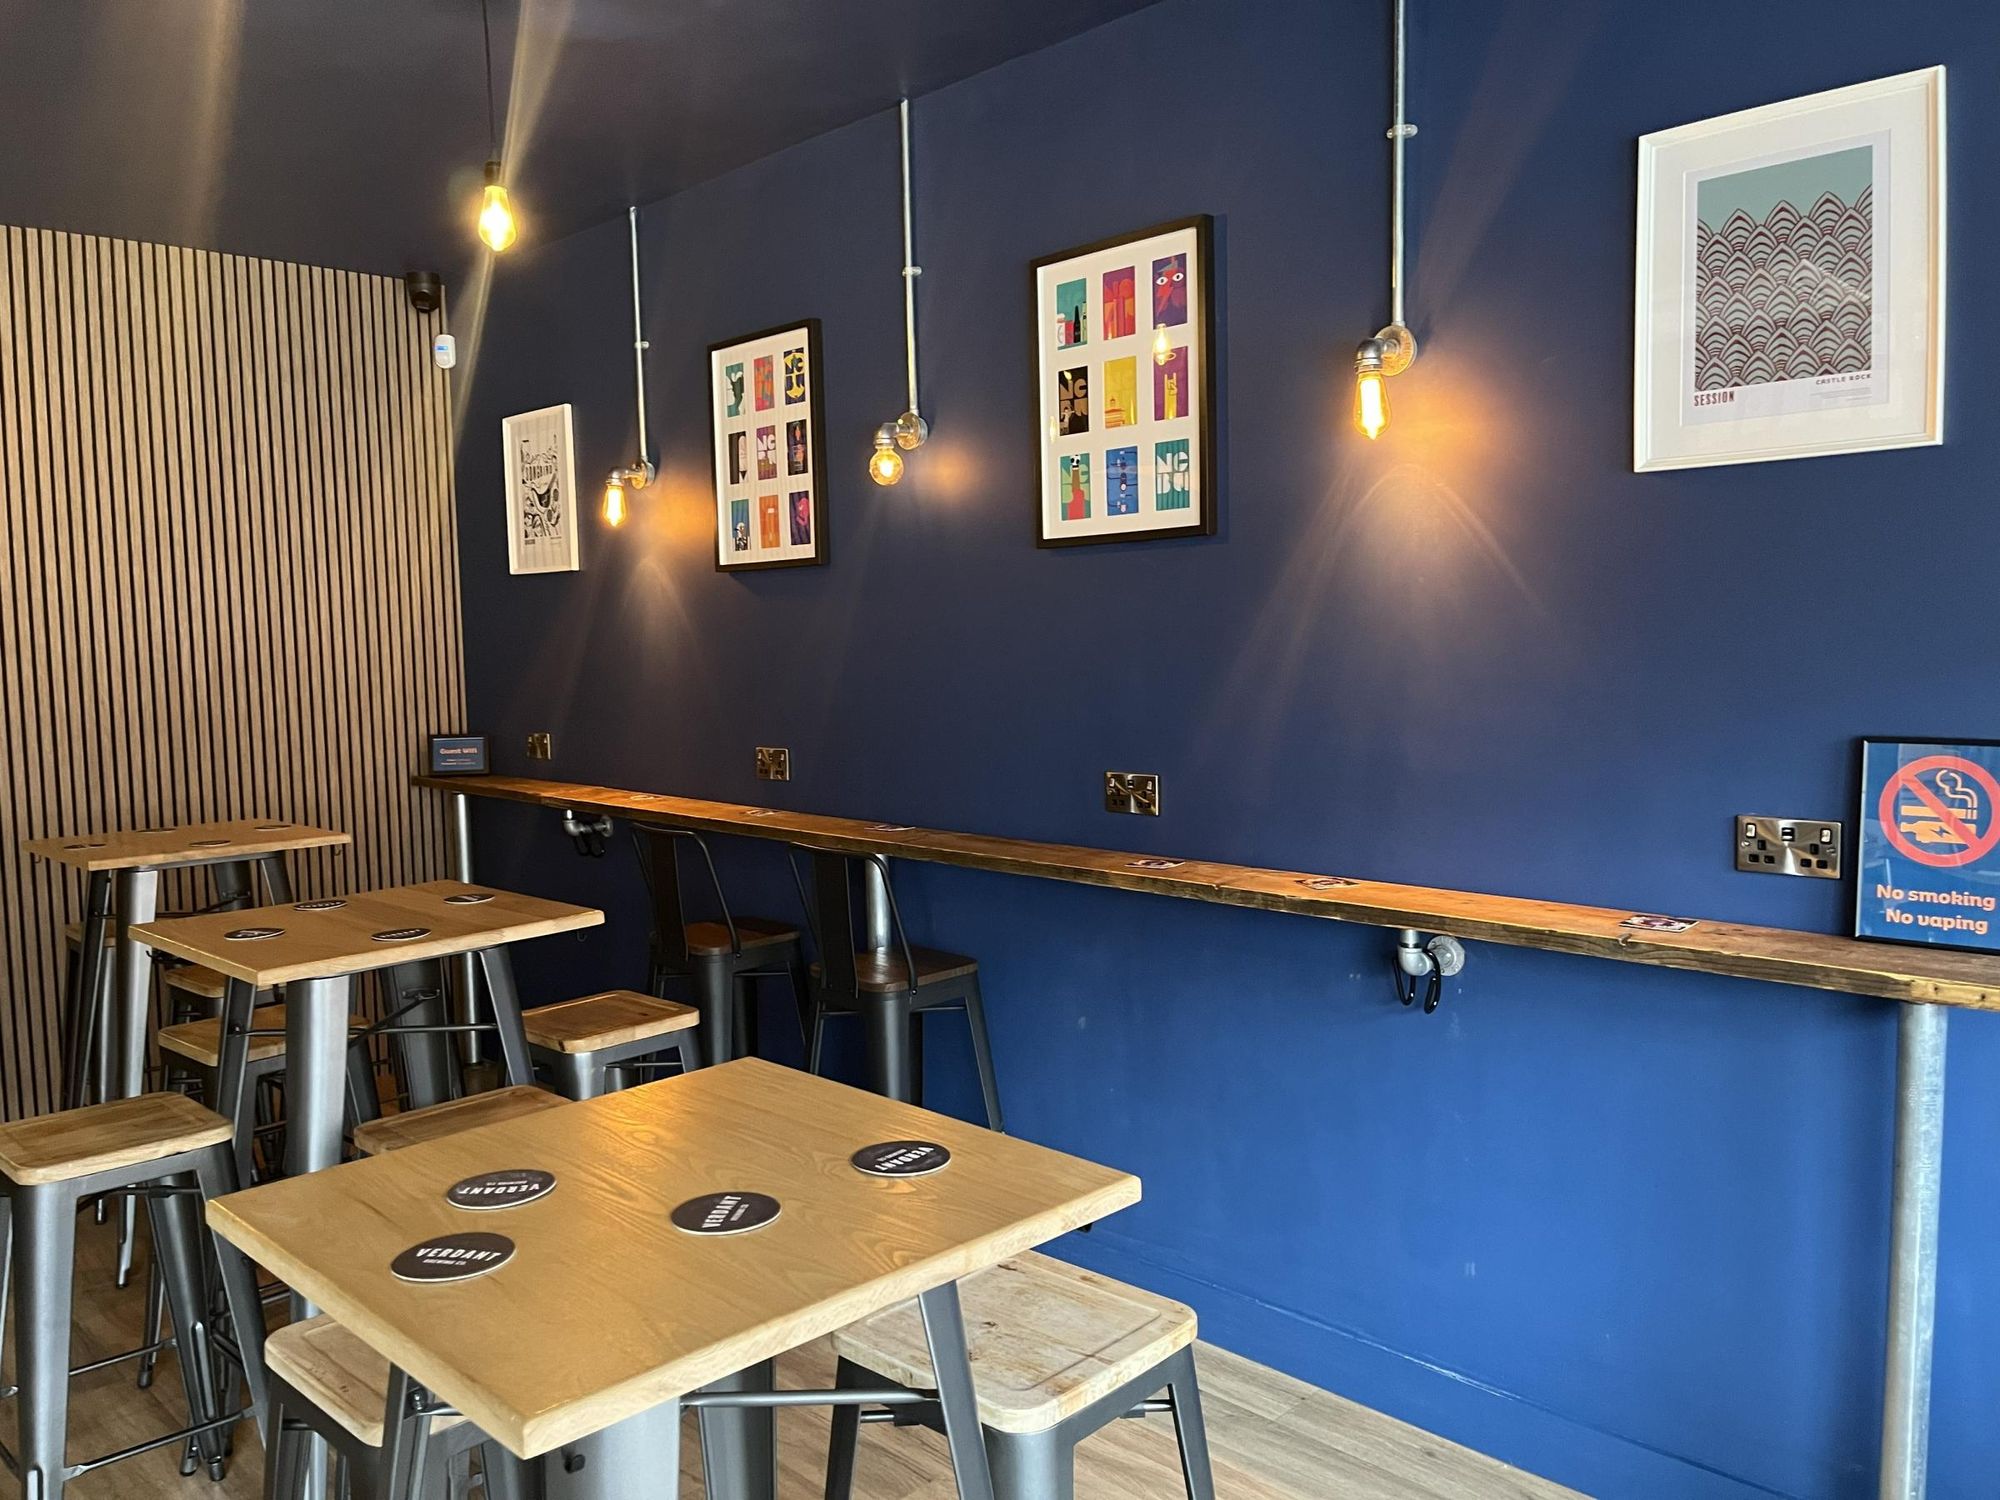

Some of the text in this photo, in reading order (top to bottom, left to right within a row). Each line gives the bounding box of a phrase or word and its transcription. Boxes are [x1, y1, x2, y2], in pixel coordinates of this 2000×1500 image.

[1815, 373, 1872, 386] CASTLE ROCK
[1693, 390, 1735, 407] SESSION
[1876, 883, 1996, 912] No smoking
[1885, 908, 1989, 936] No vaping
[874, 1146, 935, 1171] VERDANT
[457, 1183, 540, 1195] VERDANT
[701, 1195, 742, 1229] VERDANT
[415, 1247, 502, 1262] VERDANT
